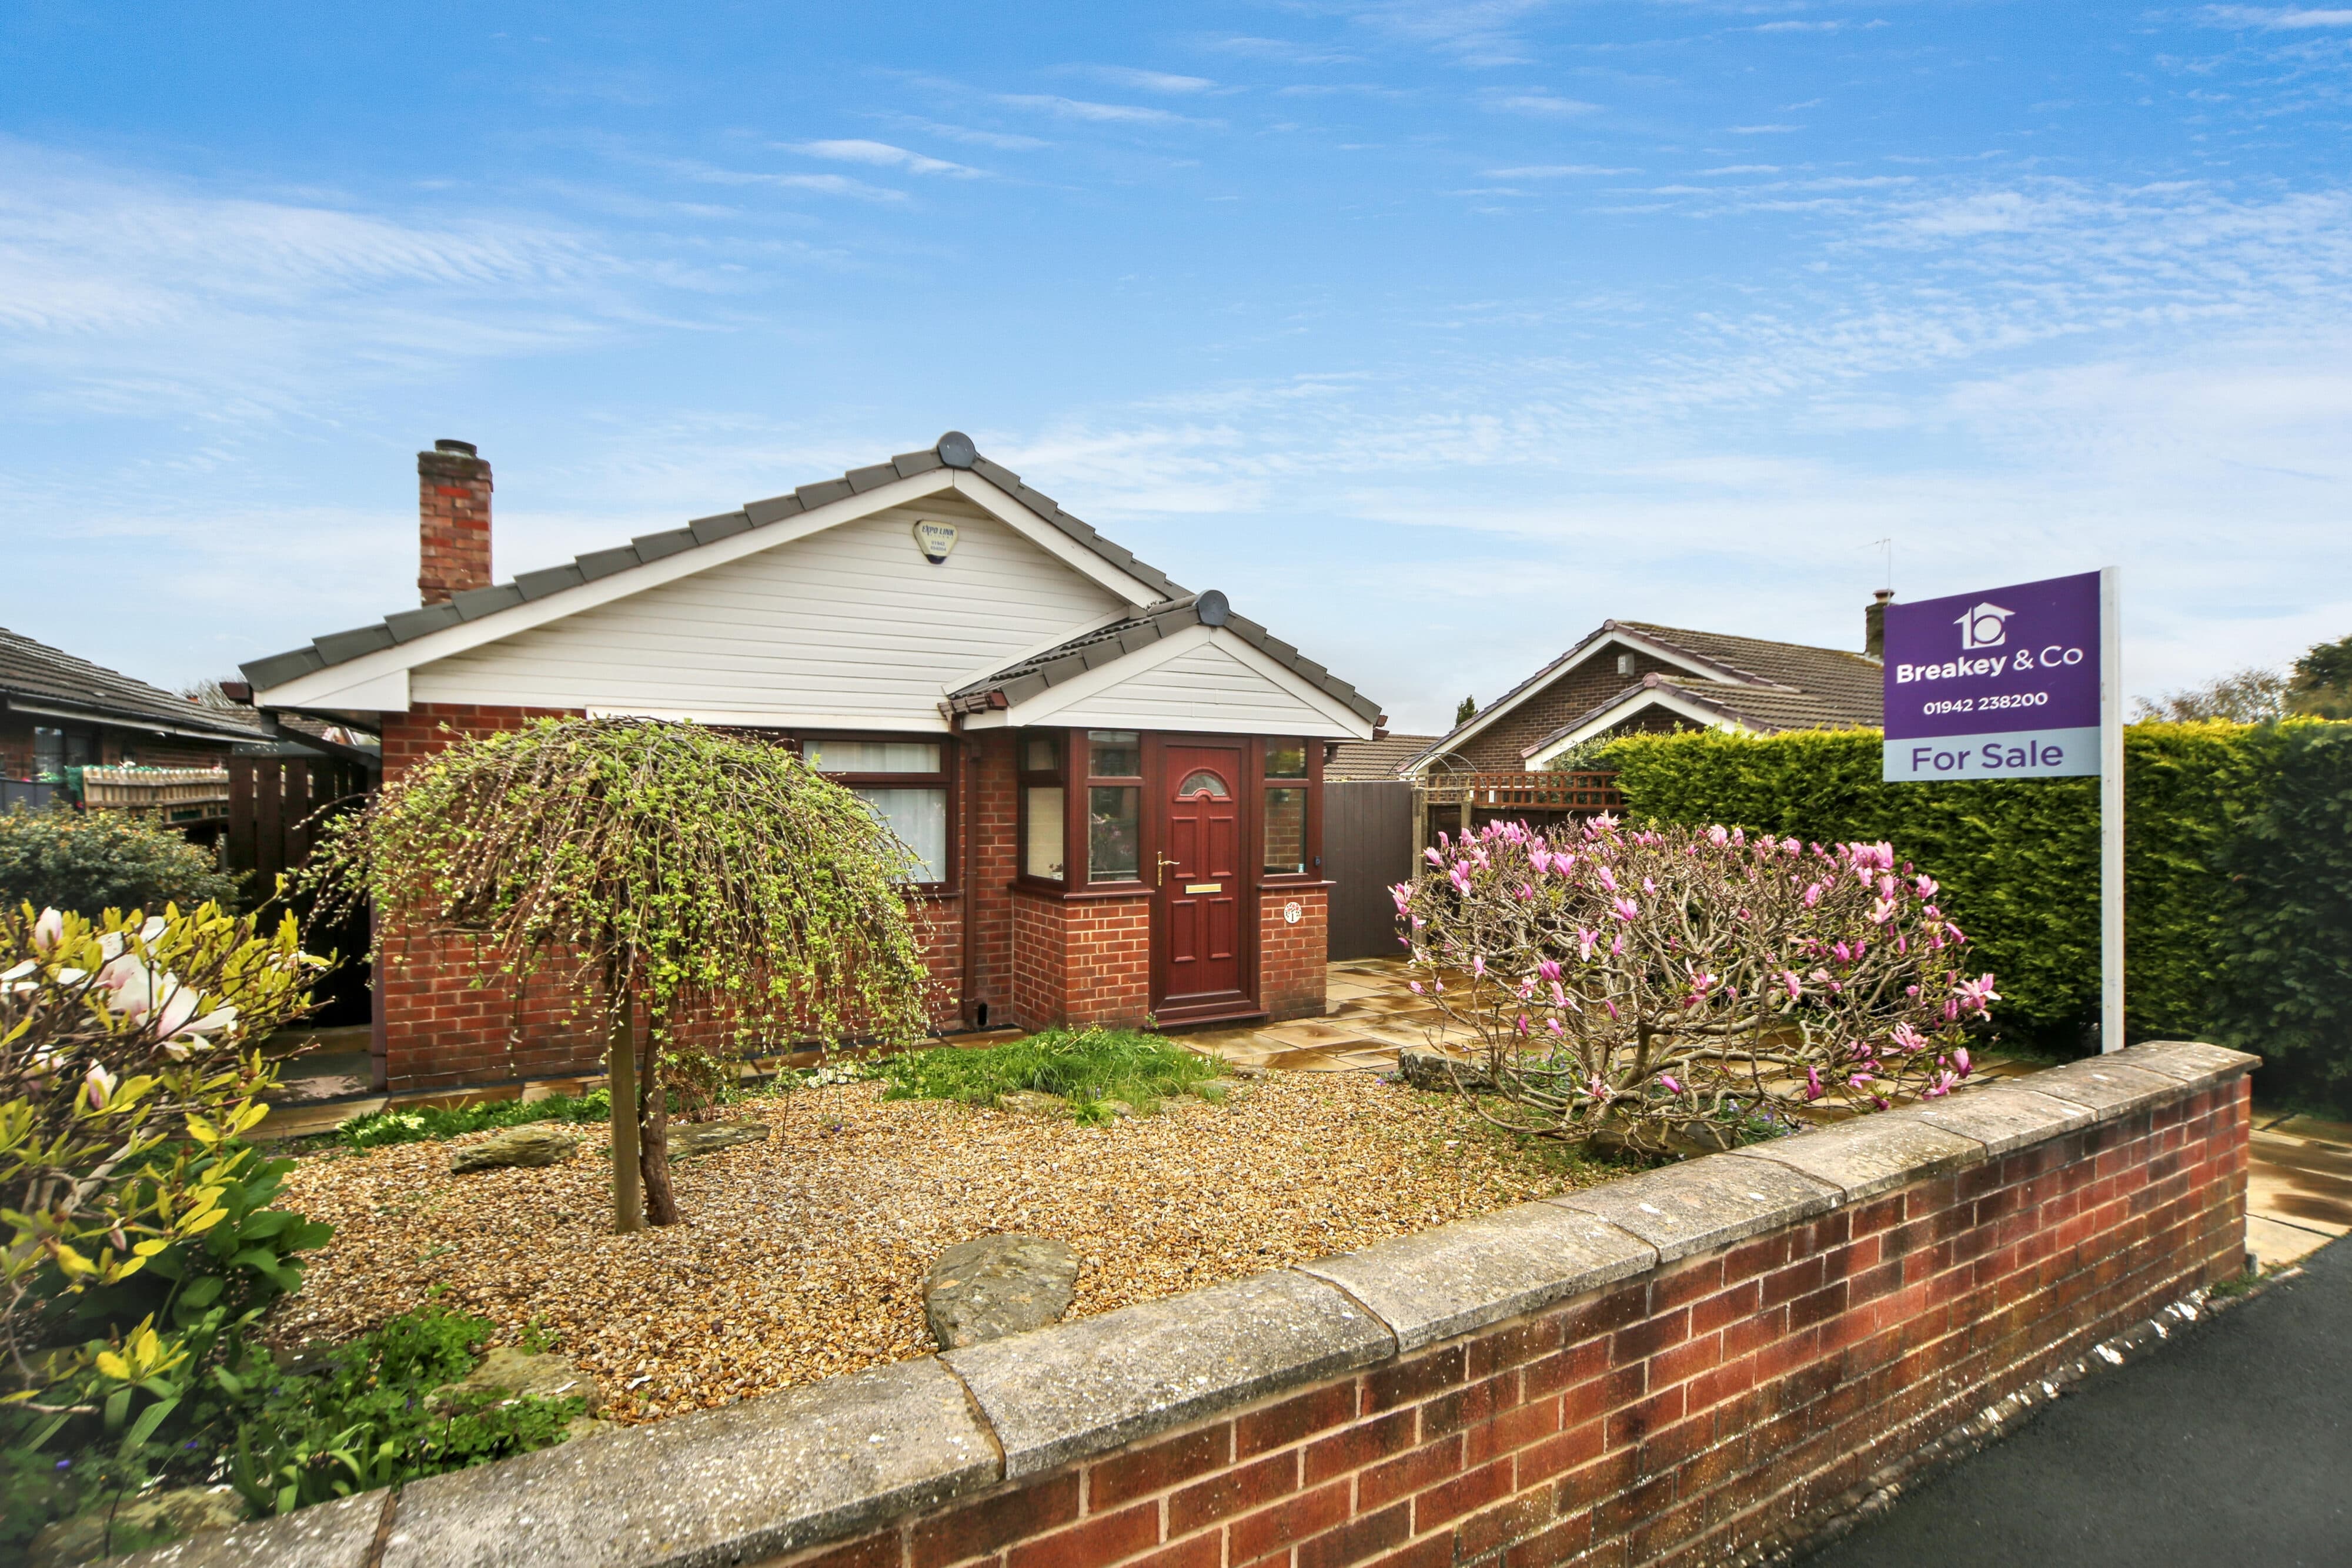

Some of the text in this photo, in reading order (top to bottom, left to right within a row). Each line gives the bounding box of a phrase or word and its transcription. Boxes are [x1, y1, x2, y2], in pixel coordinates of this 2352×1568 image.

[1896, 646, 2083, 683] Breakey & Co
[1923, 692, 2048, 716] 01942 238200
[1912, 740, 2064, 772] For Sale
